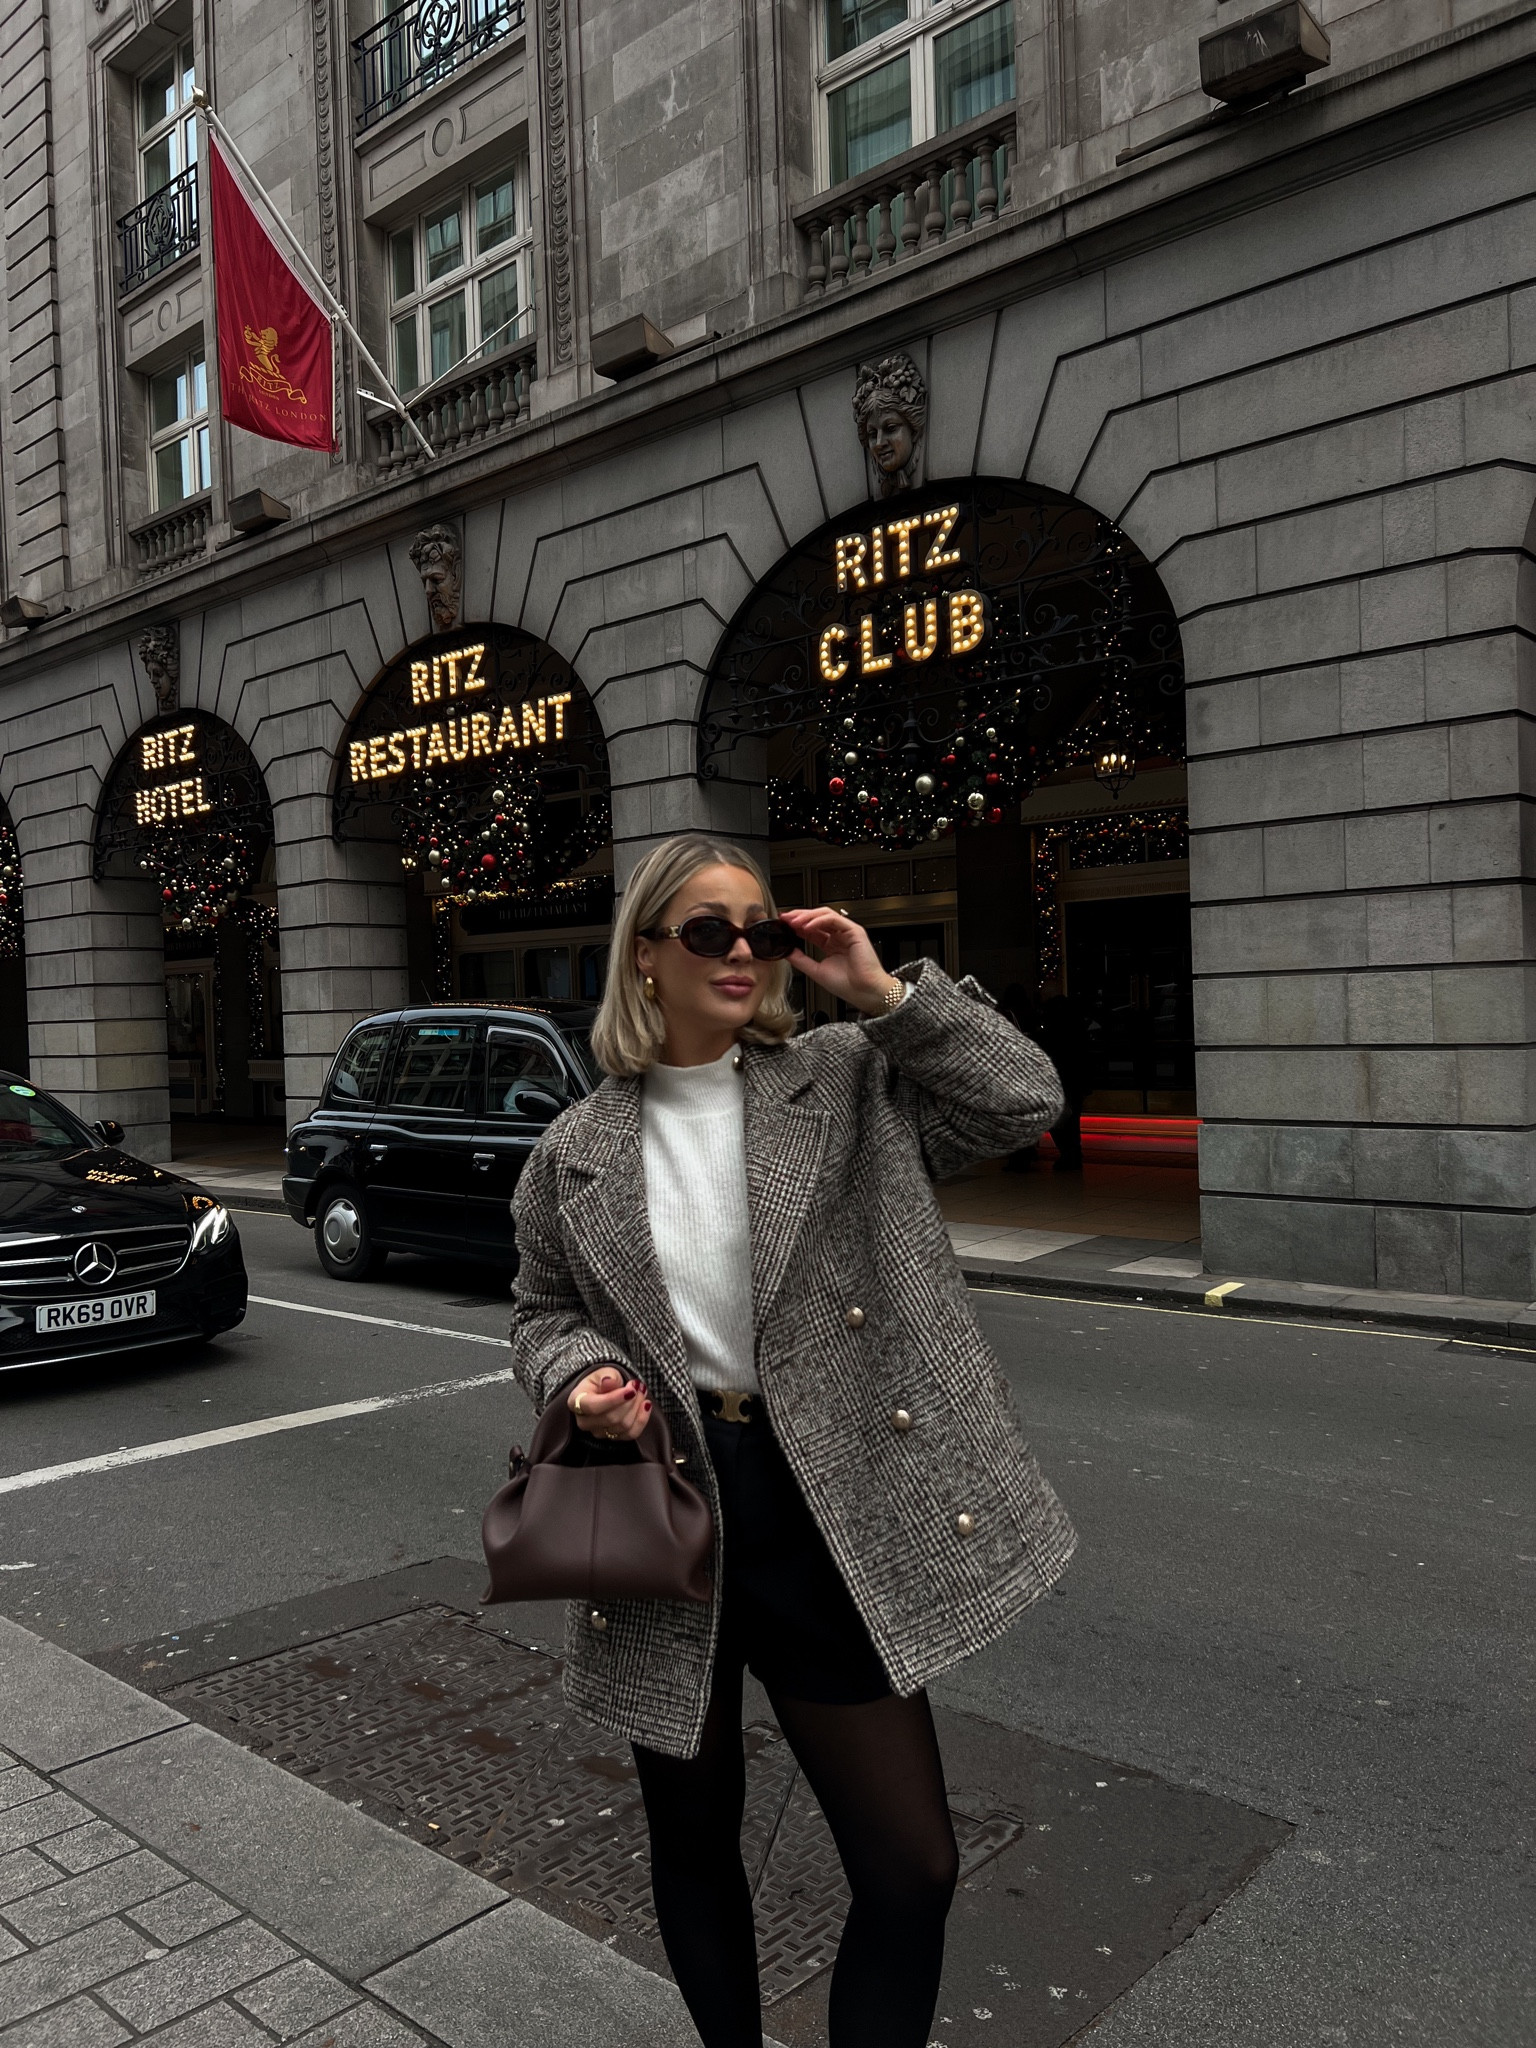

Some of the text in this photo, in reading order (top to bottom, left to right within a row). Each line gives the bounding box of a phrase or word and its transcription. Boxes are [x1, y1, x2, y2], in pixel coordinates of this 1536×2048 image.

[257, 376, 281, 389] RITZ
[275, 407, 327, 421] LONDON
[836, 502, 961, 594] RITZ
[819, 589, 986, 682] CLUB
[410, 643, 486, 705] RITZ
[142, 724, 195, 771] RITZ
[350, 691, 572, 782] RESTAURANT
[135, 777, 210, 825] HOTEL
[47, 1295, 148, 1328] RK69 OVR
